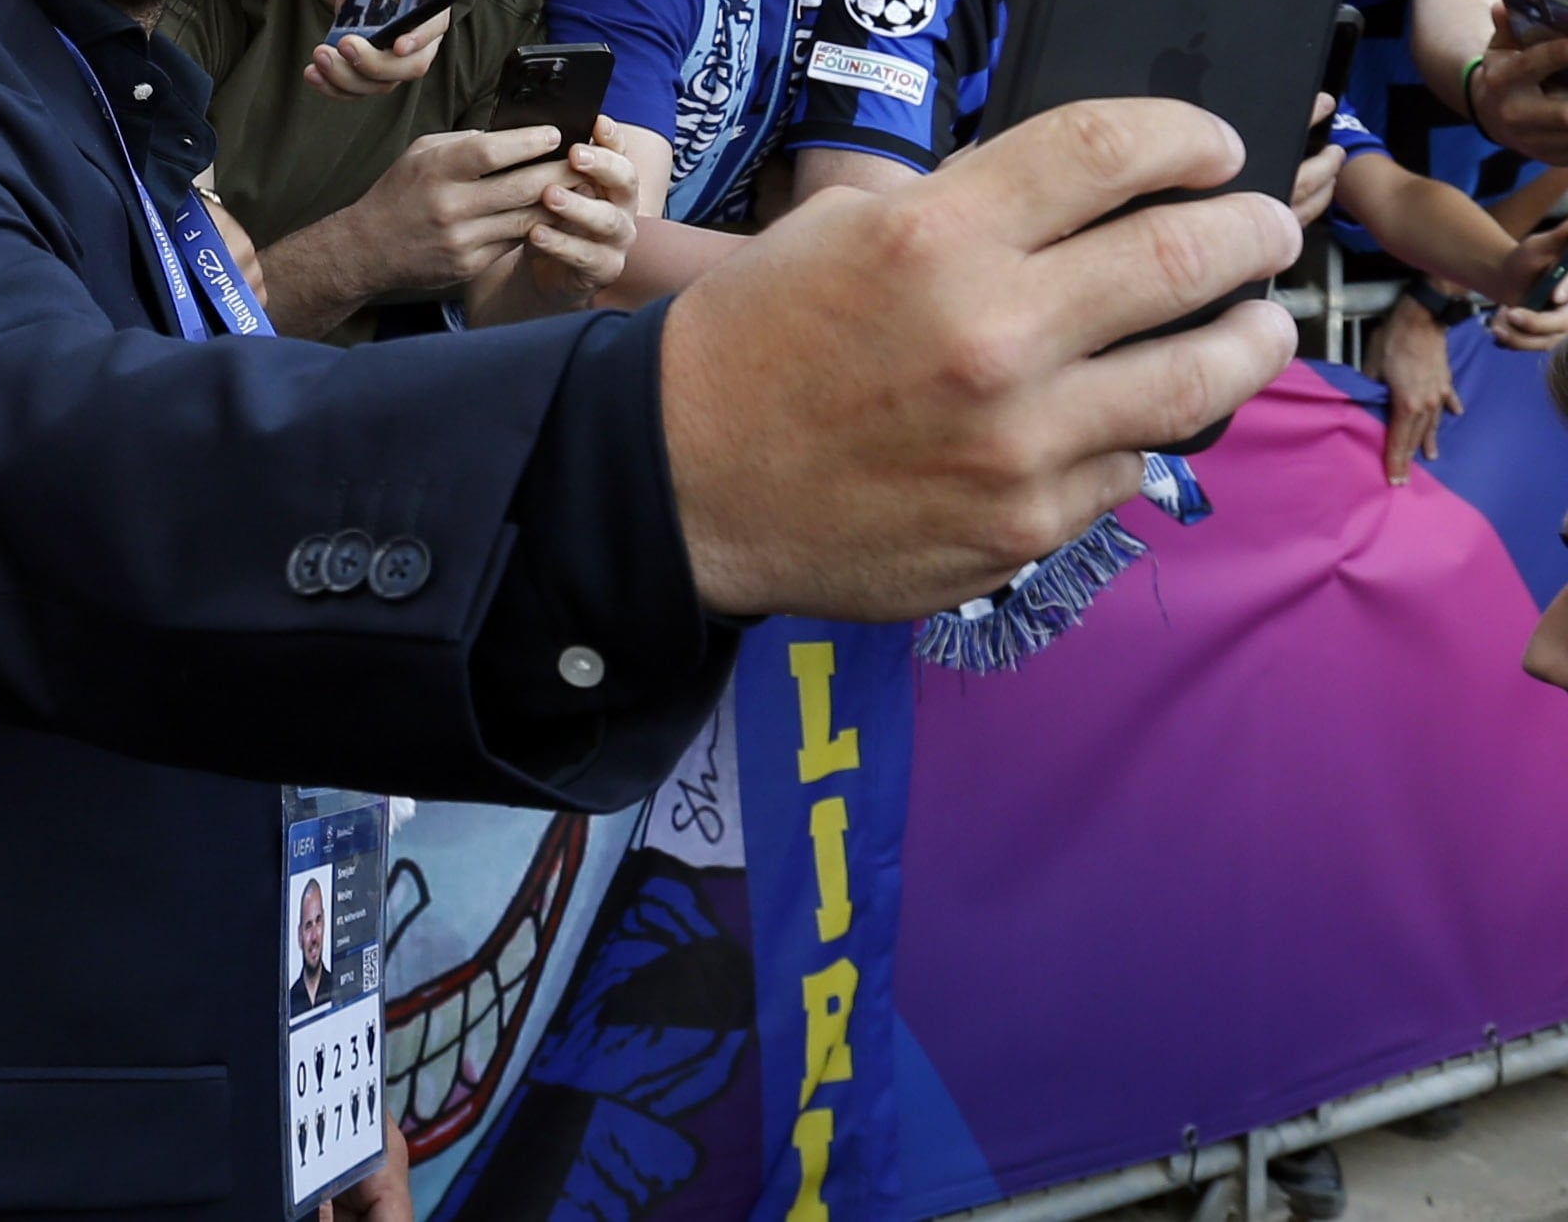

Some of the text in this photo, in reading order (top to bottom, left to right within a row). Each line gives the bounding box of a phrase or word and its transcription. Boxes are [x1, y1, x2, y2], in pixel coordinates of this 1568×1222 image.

[814, 53, 924, 93] FOUNDATION
[293, 836, 315, 858] UEFA
[334, 1104, 343, 1141] 7
